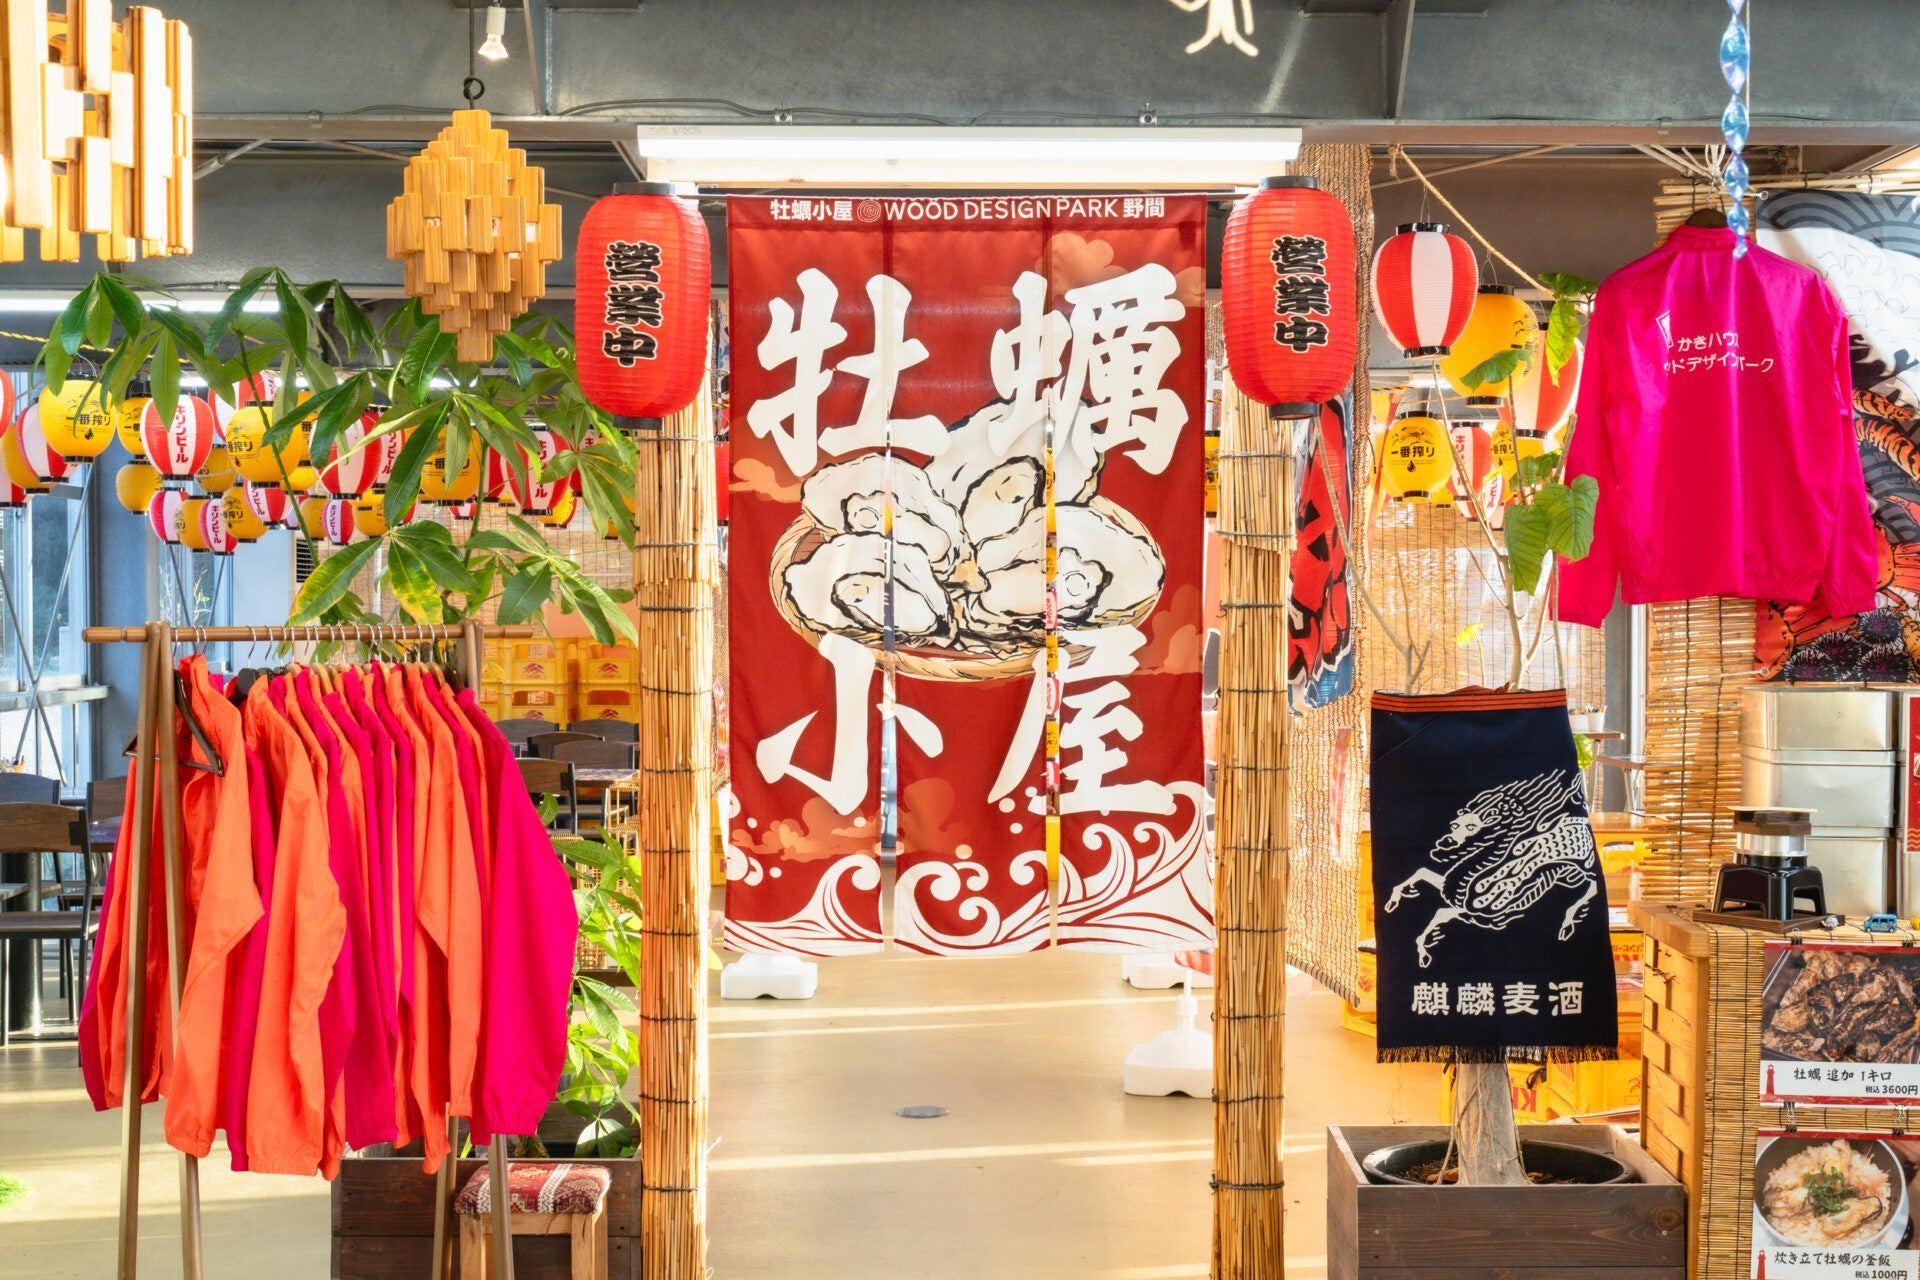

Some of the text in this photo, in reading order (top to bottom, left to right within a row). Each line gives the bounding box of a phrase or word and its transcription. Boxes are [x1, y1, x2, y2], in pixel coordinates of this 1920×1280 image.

[771, 197, 1165, 222] 牡蠣小屋 WOOD DESIGN PARK 野間
[746, 262, 1189, 477] 牡蠣
[65, 413, 111, 426] 一番搾り
[176, 405, 189, 464] キリンビール
[382, 431, 398, 474] リンビール
[1391, 446, 1435, 458] 一番搾り
[424, 457, 470, 470] 一番り
[211, 505, 222, 544] キリンビール
[756, 624, 1177, 816] 小屋
[1411, 981, 1583, 1016] 麒麟麦酒
[1827, 1068, 1854, 1082] 追加
[1865, 1084, 1918, 1096] 税込 3600円
[1774, 1250, 1891, 1267] 炊き立て牡蠣の釜飯
[1872, 1269, 1907, 1280] 1000円
